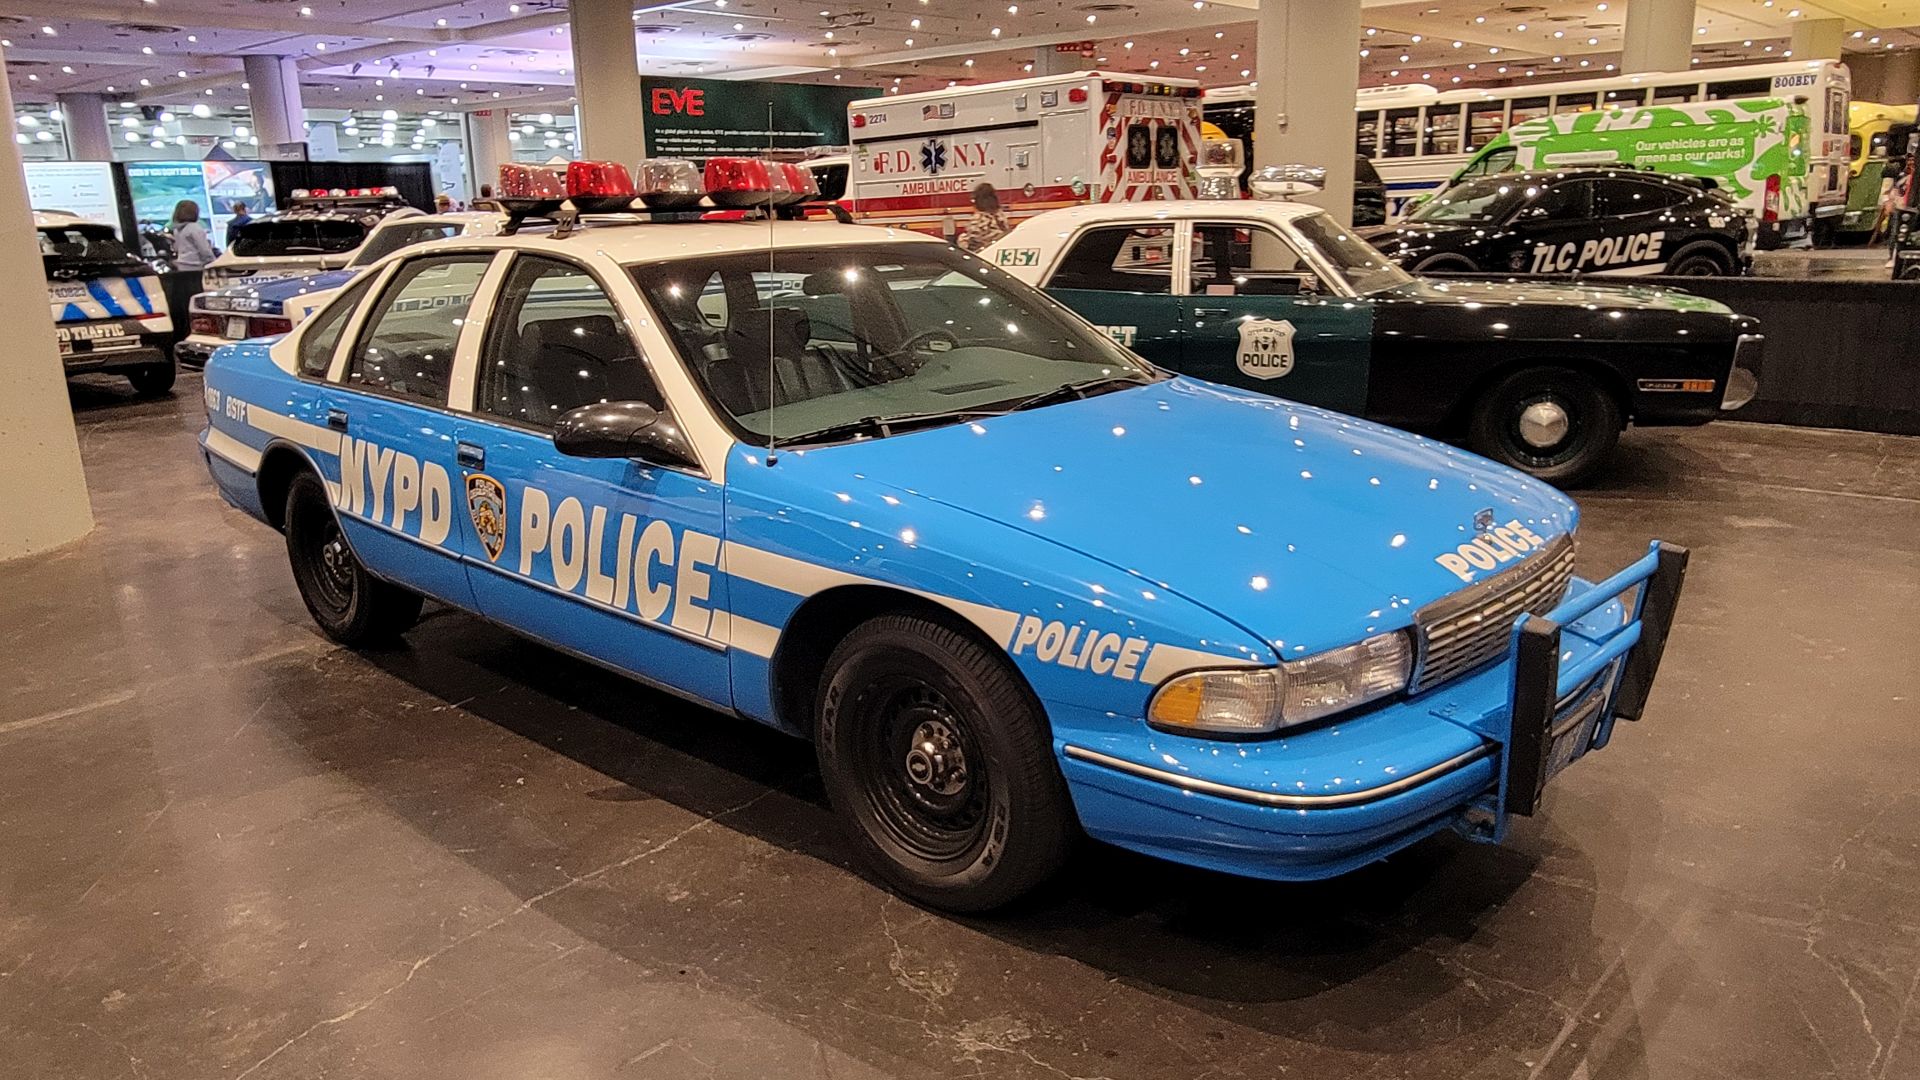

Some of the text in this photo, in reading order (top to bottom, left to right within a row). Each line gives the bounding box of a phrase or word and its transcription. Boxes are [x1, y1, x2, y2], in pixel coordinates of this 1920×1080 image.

[1774, 75, 1818, 88] 800BEV
[651, 87, 705, 116] EVE
[869, 114, 887, 124] 2274
[1636, 137, 1744, 151] Our vehicles are as
[879, 142, 995, 174] F.D. N.Y.
[1635, 148, 1745, 165] green as our parks!
[902, 179, 968, 195] AMBULANCE
[997, 249, 1039, 266] 1357
[1530, 231, 1666, 274] TLC POLICE
[70, 324, 125, 340] TRAFFIC
[1242, 353, 1288, 368] POLICE
[340, 435, 451, 546] NYPD
[1434, 519, 1545, 583] POLICE
[518, 486, 721, 639] POLICE
[1012, 615, 1149, 680] POLICE
